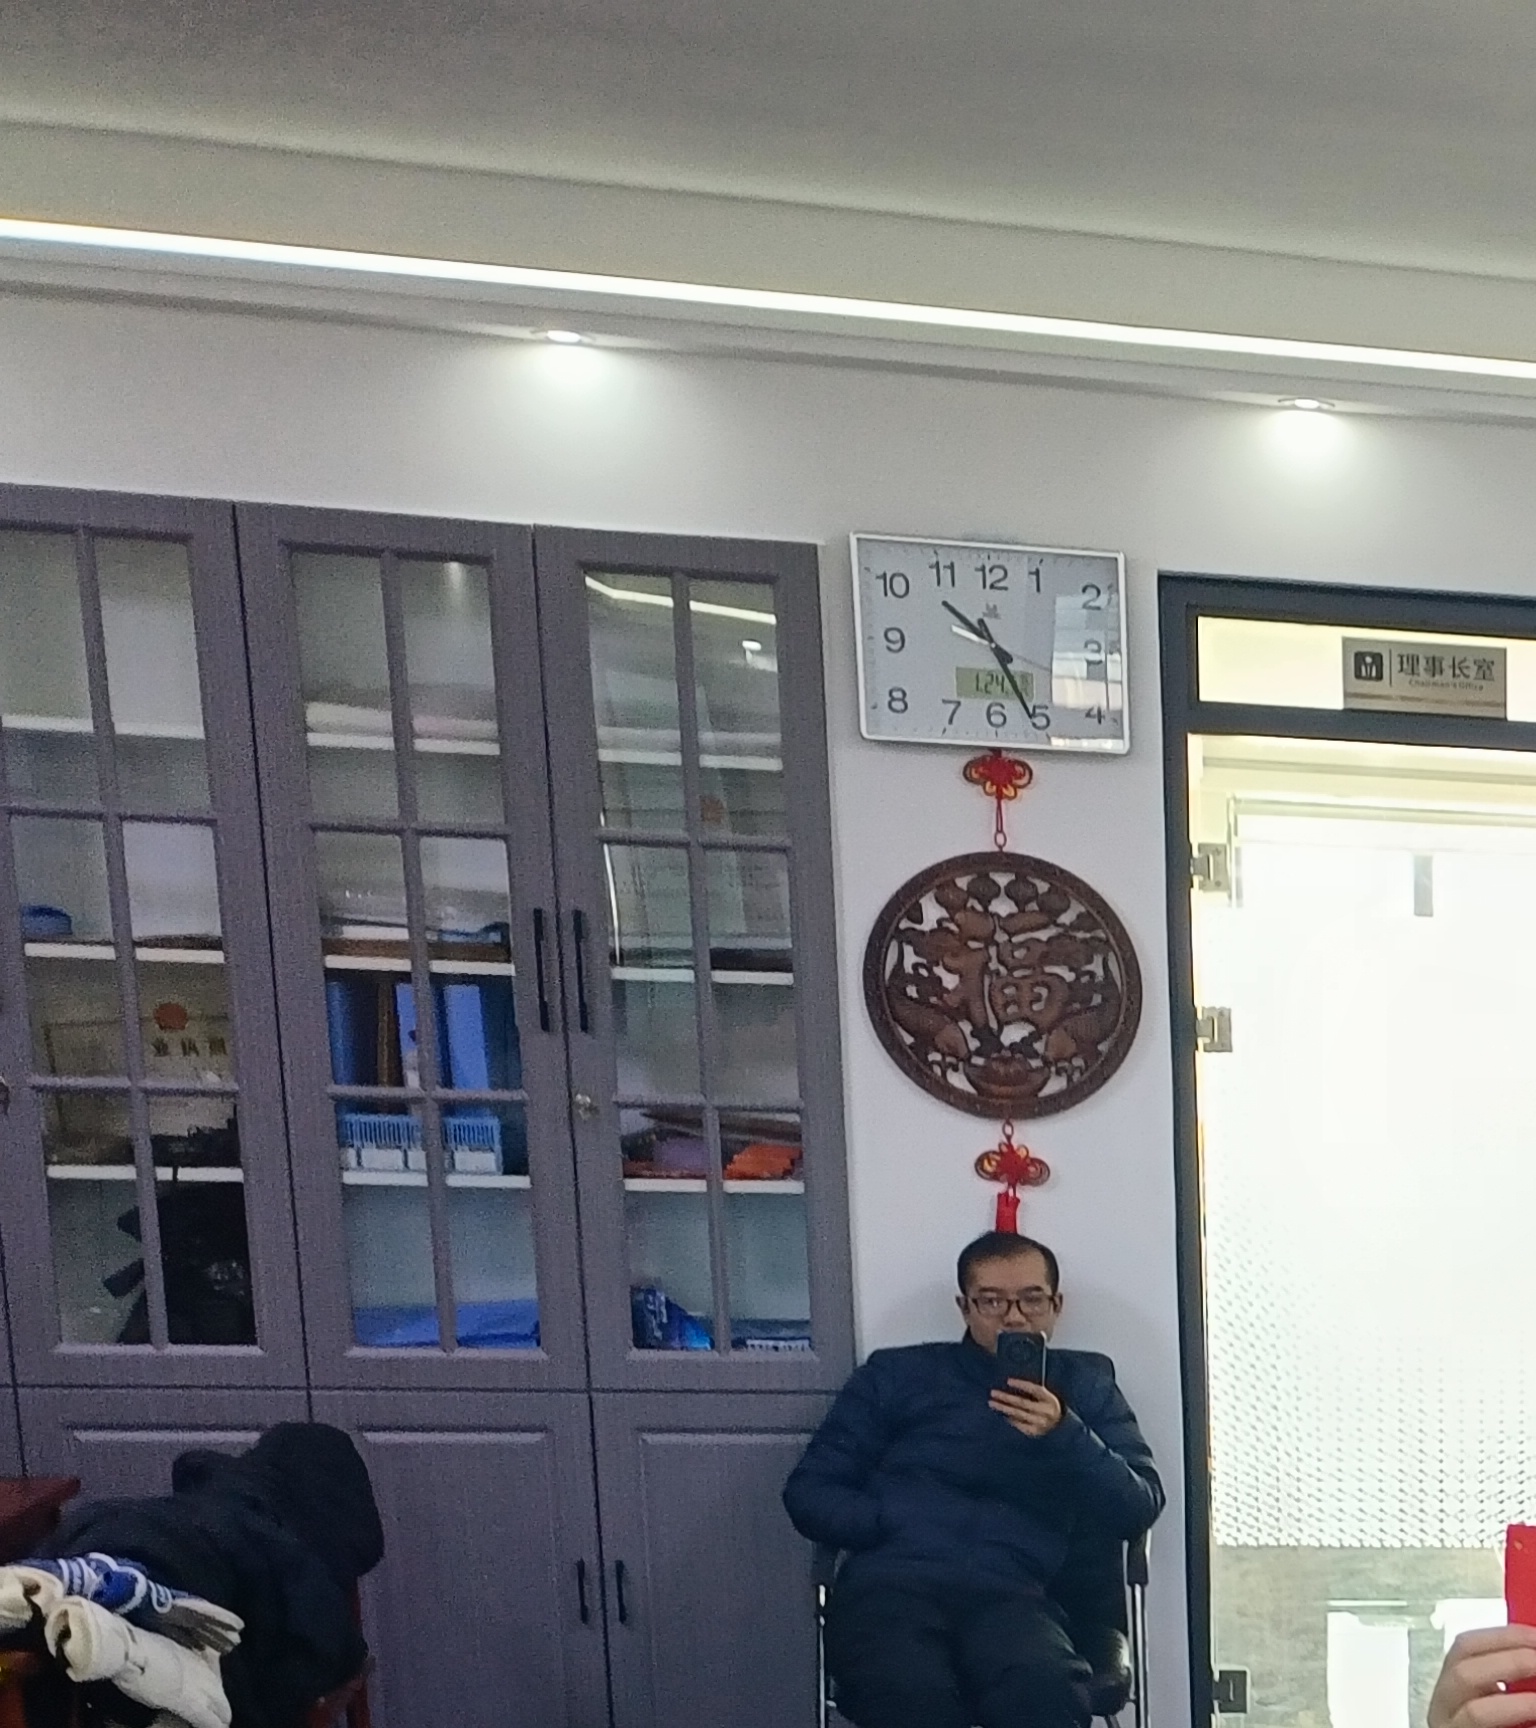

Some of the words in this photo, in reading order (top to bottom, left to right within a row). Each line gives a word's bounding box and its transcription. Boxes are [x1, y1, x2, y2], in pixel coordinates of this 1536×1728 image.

[875, 571, 911, 599] 10
[928, 560, 956, 588] 11
[974, 563, 1009, 591] 12
[1028, 566, 1042, 593] 1
[1081, 583, 1102, 611] 2
[883, 626, 906, 653] 9
[1083, 639, 1103, 665] 3
[1397, 652, 1495, 682] 理事长室
[887, 686, 909, 714] 8
[941, 698, 962, 726] 7
[985, 702, 1008, 729] 6
[1030, 704, 1051, 731] 5
